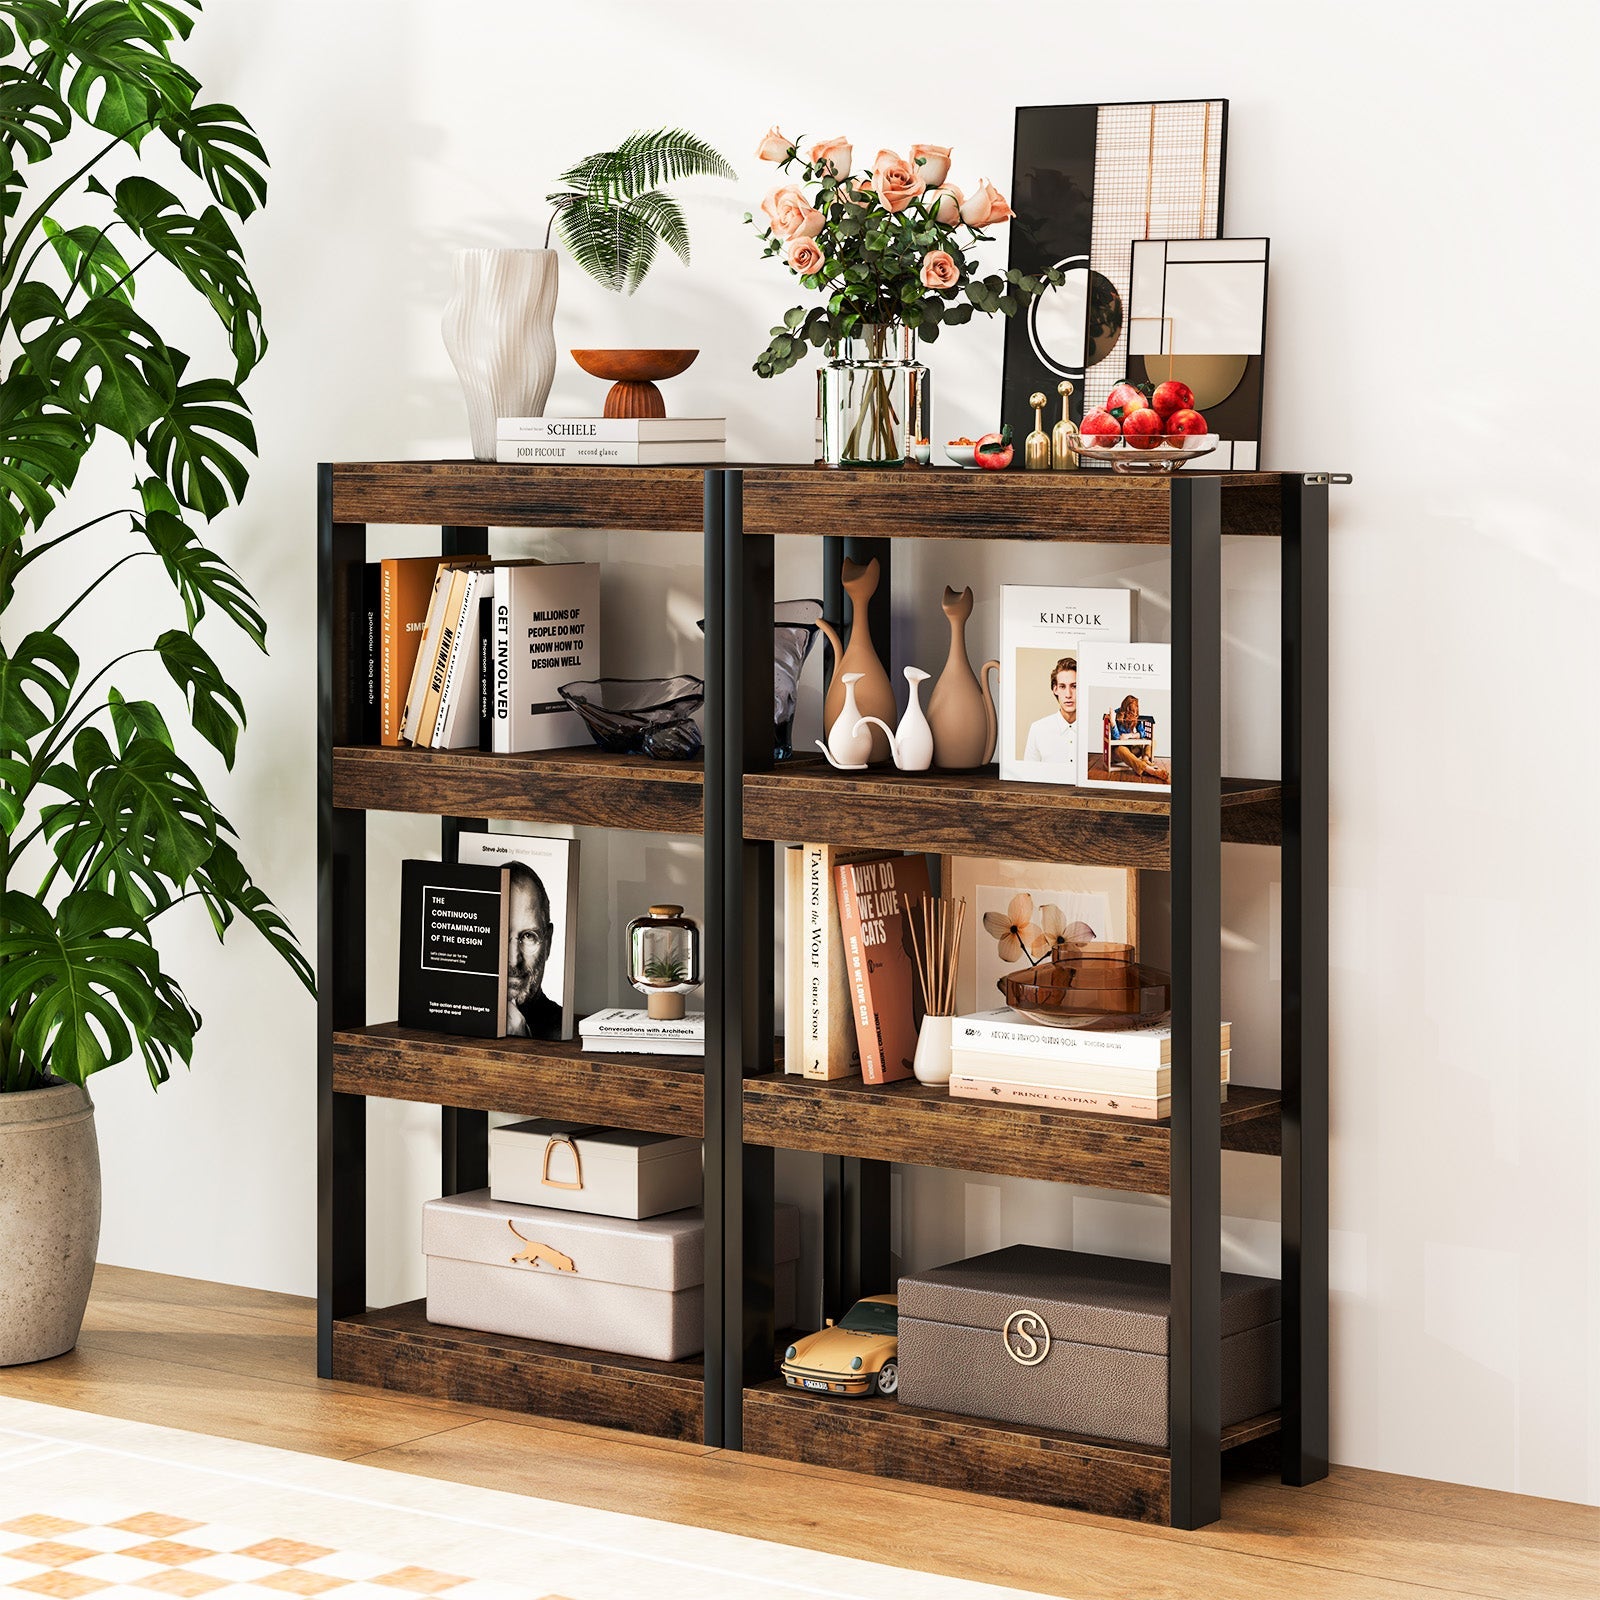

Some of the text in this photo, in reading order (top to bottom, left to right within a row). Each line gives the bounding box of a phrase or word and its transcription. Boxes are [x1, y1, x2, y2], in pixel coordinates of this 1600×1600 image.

[547, 424, 597, 436] SCHIELE
[517, 447, 566, 458] JODI PICOULT
[599, 448, 618, 457] glance
[459, 583, 472, 628] simplicity
[533, 609, 580, 621] MILLIONS OF
[1040, 612, 1102, 626] KINFOLK
[384, 623, 391, 631] is
[528, 624, 585, 638] PEOPLE DO NOT
[384, 634, 391, 645] in
[530, 640, 583, 653] KNOW HOW TO
[432, 627, 453, 693] MINIMALISM
[498, 605, 508, 720] GET INVOLVED
[532, 656, 581, 669] DESIGN WELL
[1107, 662, 1155, 672] KINFOLK
[383, 647, 391, 700] everything
[384, 702, 390, 716] we
[482, 845, 496, 853] Steve
[850, 862, 895, 893] WHY DO
[432, 896, 445, 905] THE
[856, 890, 899, 920] WE LOVE
[431, 909, 478, 920] CONTINUOUS
[811, 849, 822, 969] TAMING the WOLF
[431, 922, 491, 934] CONTAMINATION
[861, 919, 887, 947] CATS
[430, 934, 483, 946] OF THE DESIGN
[850, 935, 868, 1026] WHY DO WE LOVE CATS
[812, 977, 820, 1041] GREG STONE
[1012, 1090, 1097, 1105] PRINCE CASPIAN
[1016, 1317, 1037, 1359] S
